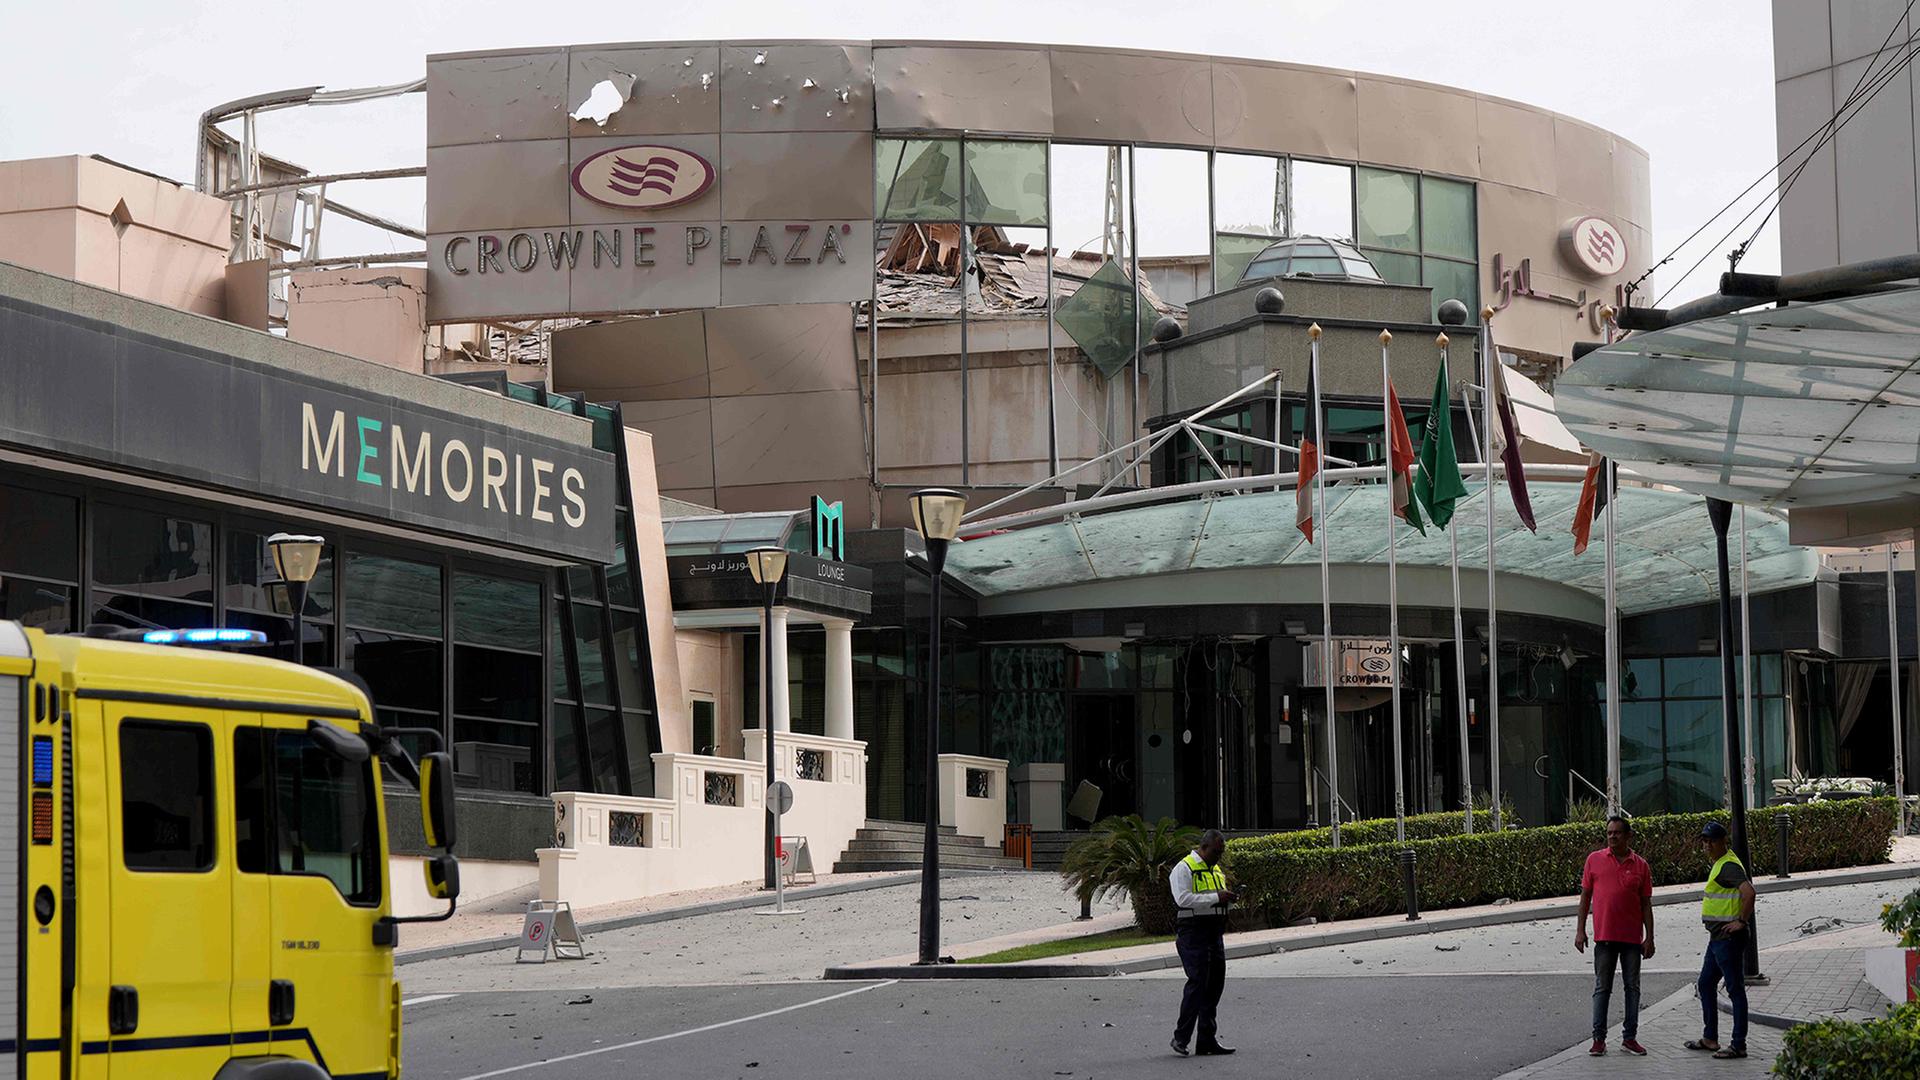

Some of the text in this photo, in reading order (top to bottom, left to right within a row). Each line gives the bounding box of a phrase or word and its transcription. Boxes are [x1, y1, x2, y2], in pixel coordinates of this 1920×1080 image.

[444, 224, 847, 275] CROWNE PLAZA
[301, 402, 587, 529] MEMORIES
[689, 559, 725, 576] لاونج
[817, 563, 845, 582] LOUNGE
